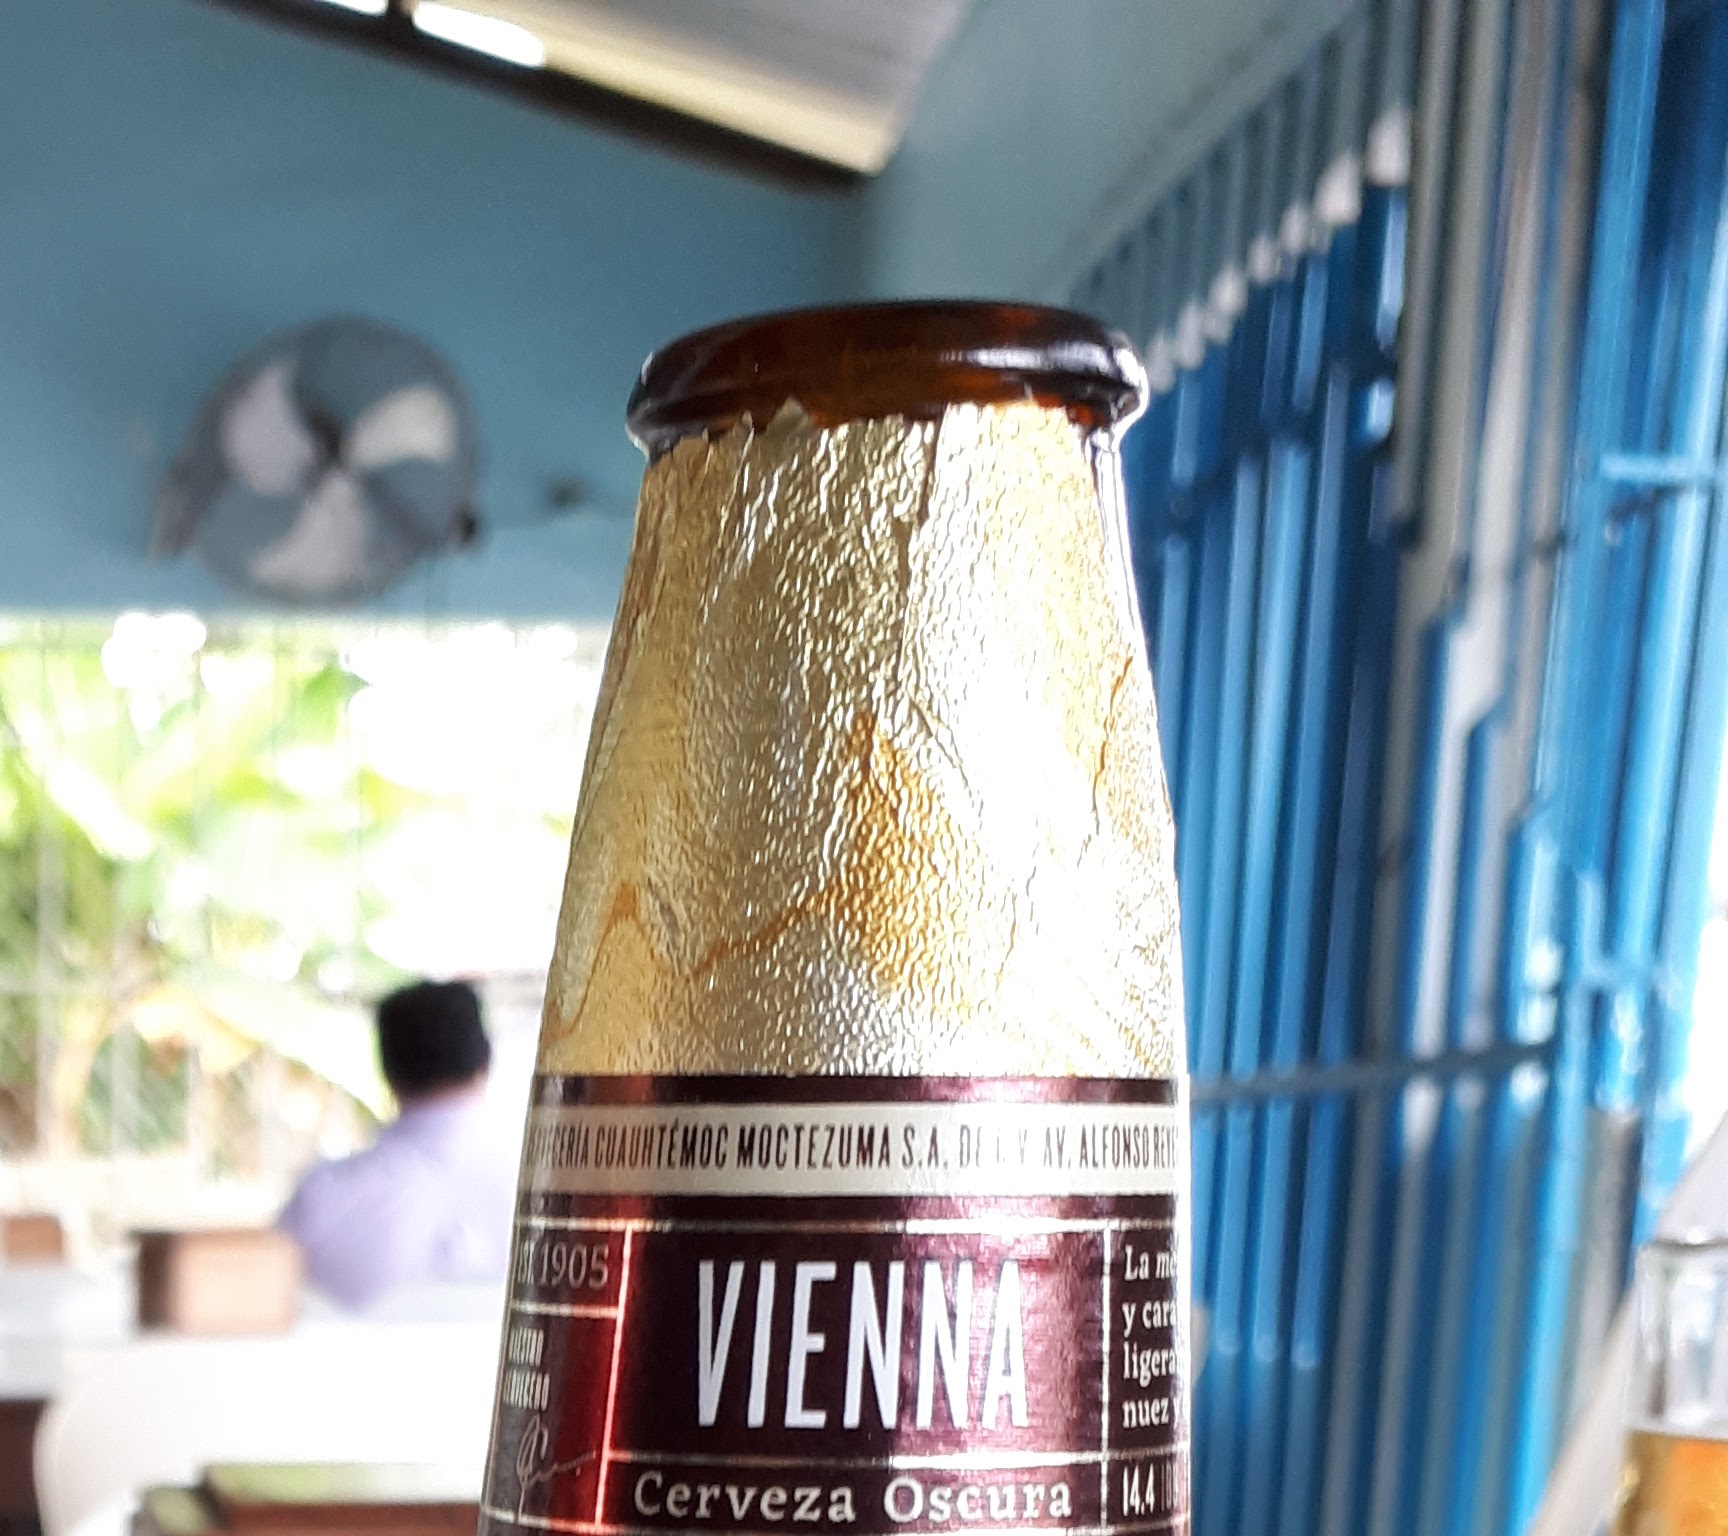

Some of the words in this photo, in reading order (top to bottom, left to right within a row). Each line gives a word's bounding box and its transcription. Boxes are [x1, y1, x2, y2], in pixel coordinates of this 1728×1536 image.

[593, 1117, 730, 1171] CUAUHTÉMOC
[735, 1121, 891, 1171] MOCTEZUMA
[901, 1121, 950, 1171] S.A.
[1078, 1121, 1151, 1170] ALFONSO
[538, 1240, 610, 1289] 1905
[1124, 1244, 1150, 1282] La
[697, 1259, 1030, 1431] VIENNA
[1121, 1301, 1138, 1339] y
[1121, 1395, 1170, 1430] nuez
[633, 1469, 858, 1524] Cerveza
[882, 1475, 1072, 1524] Oscura
[1122, 1462, 1156, 1519] 14.4
